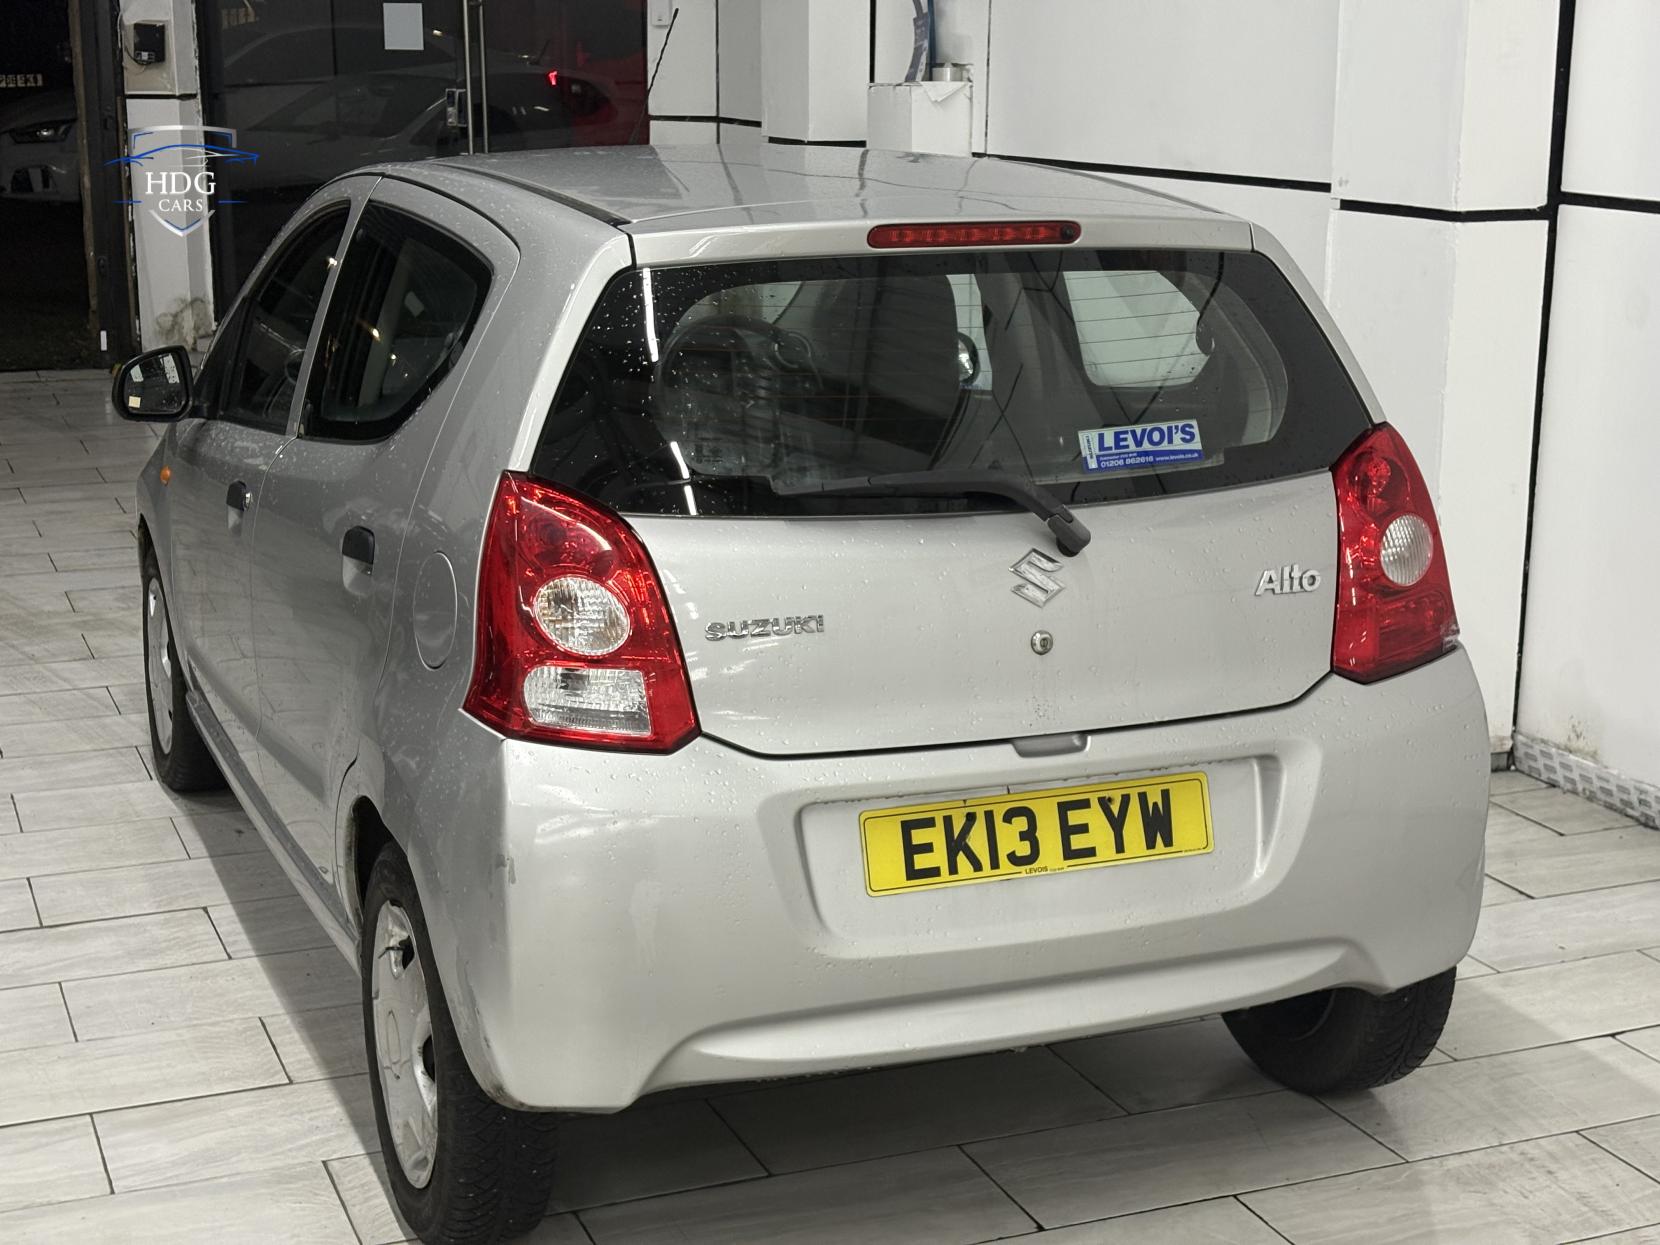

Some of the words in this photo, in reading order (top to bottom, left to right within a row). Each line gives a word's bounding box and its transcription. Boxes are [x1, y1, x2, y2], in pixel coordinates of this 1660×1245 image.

[1098, 423, 1196, 452] LEVOI'S
[1255, 564, 1322, 596] Alto
[705, 614, 825, 641] SUZUKI
[900, 806, 1041, 882] EK13
[1056, 788, 1174, 862] EYW
